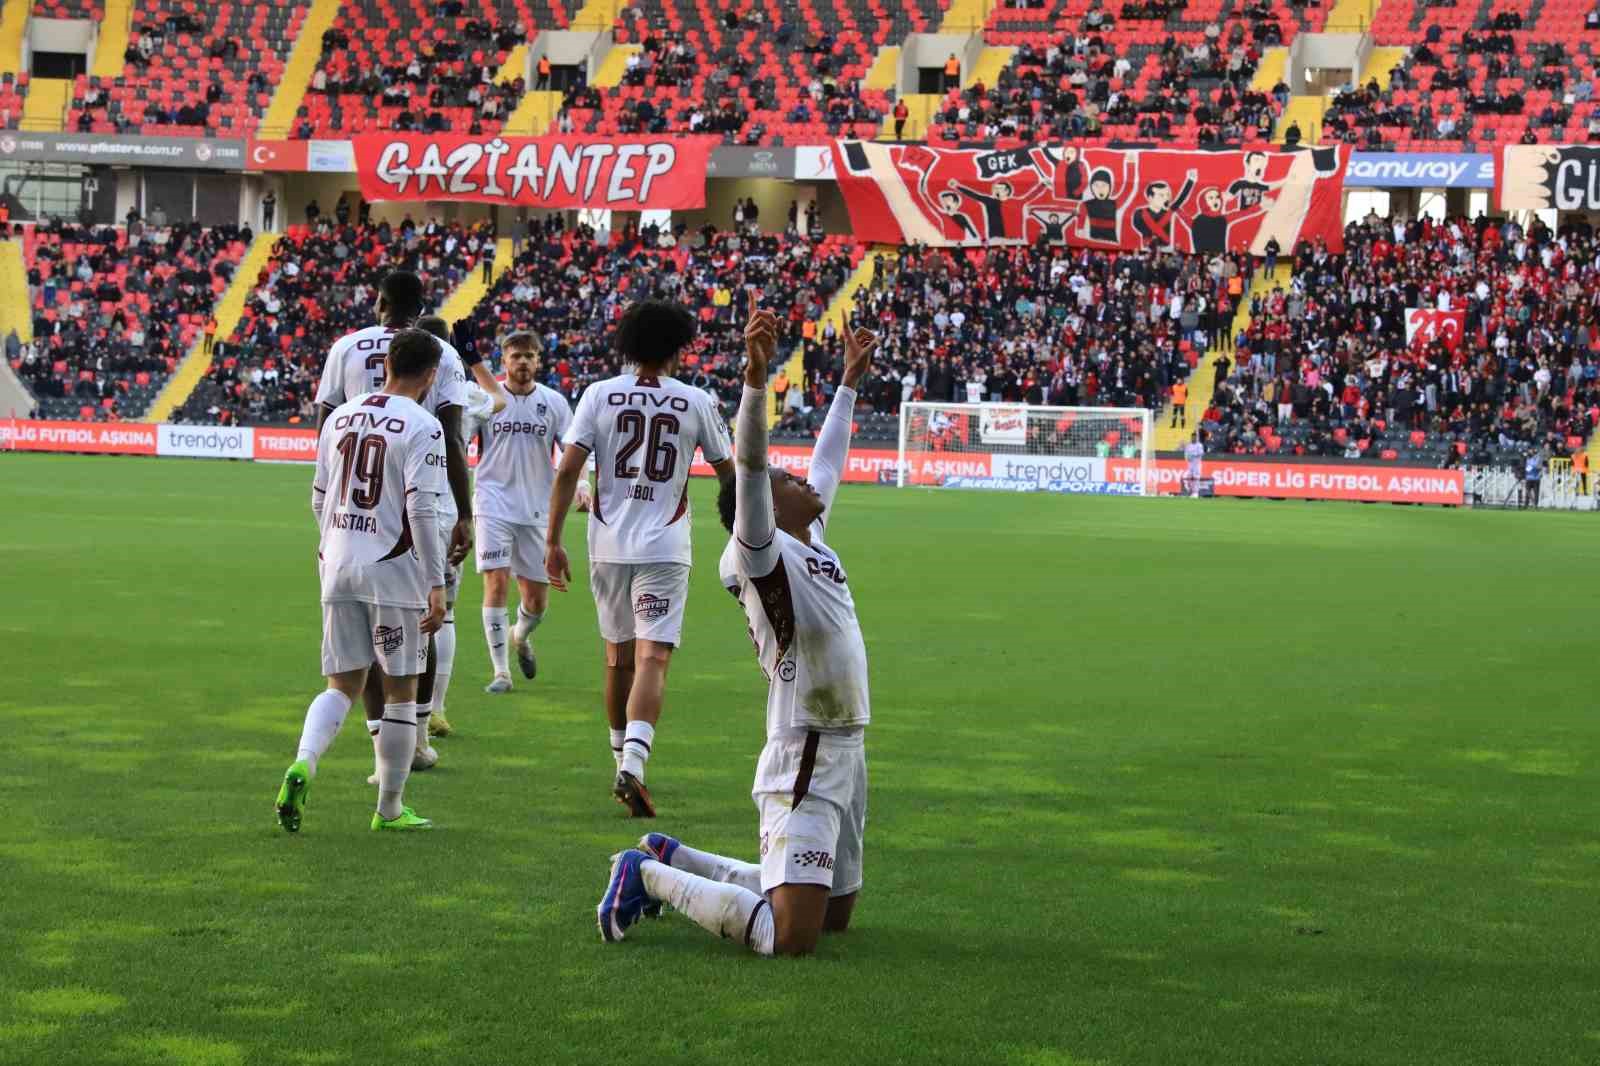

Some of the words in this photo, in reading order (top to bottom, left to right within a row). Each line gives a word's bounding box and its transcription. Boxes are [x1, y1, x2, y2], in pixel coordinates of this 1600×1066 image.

[376, 138, 676, 203] GAZİANTEP
[987, 154, 1017, 170] GFK
[39, 430, 96, 444] FUTBOL
[99, 431, 154, 446] AŞKINA
[493, 421, 547, 437] papara
[170, 432, 242, 450] trendyol
[259, 436, 318, 451] TRENDY
[615, 409, 680, 483] 26
[337, 432, 387, 510] 19
[1006, 460, 1092, 482] trendyol
[1212, 468, 1270, 487] SÜPER
[1276, 470, 1304, 489] LİG
[1310, 473, 1382, 491] FUTBOL
[1387, 477, 1459, 495] AŞKINA
